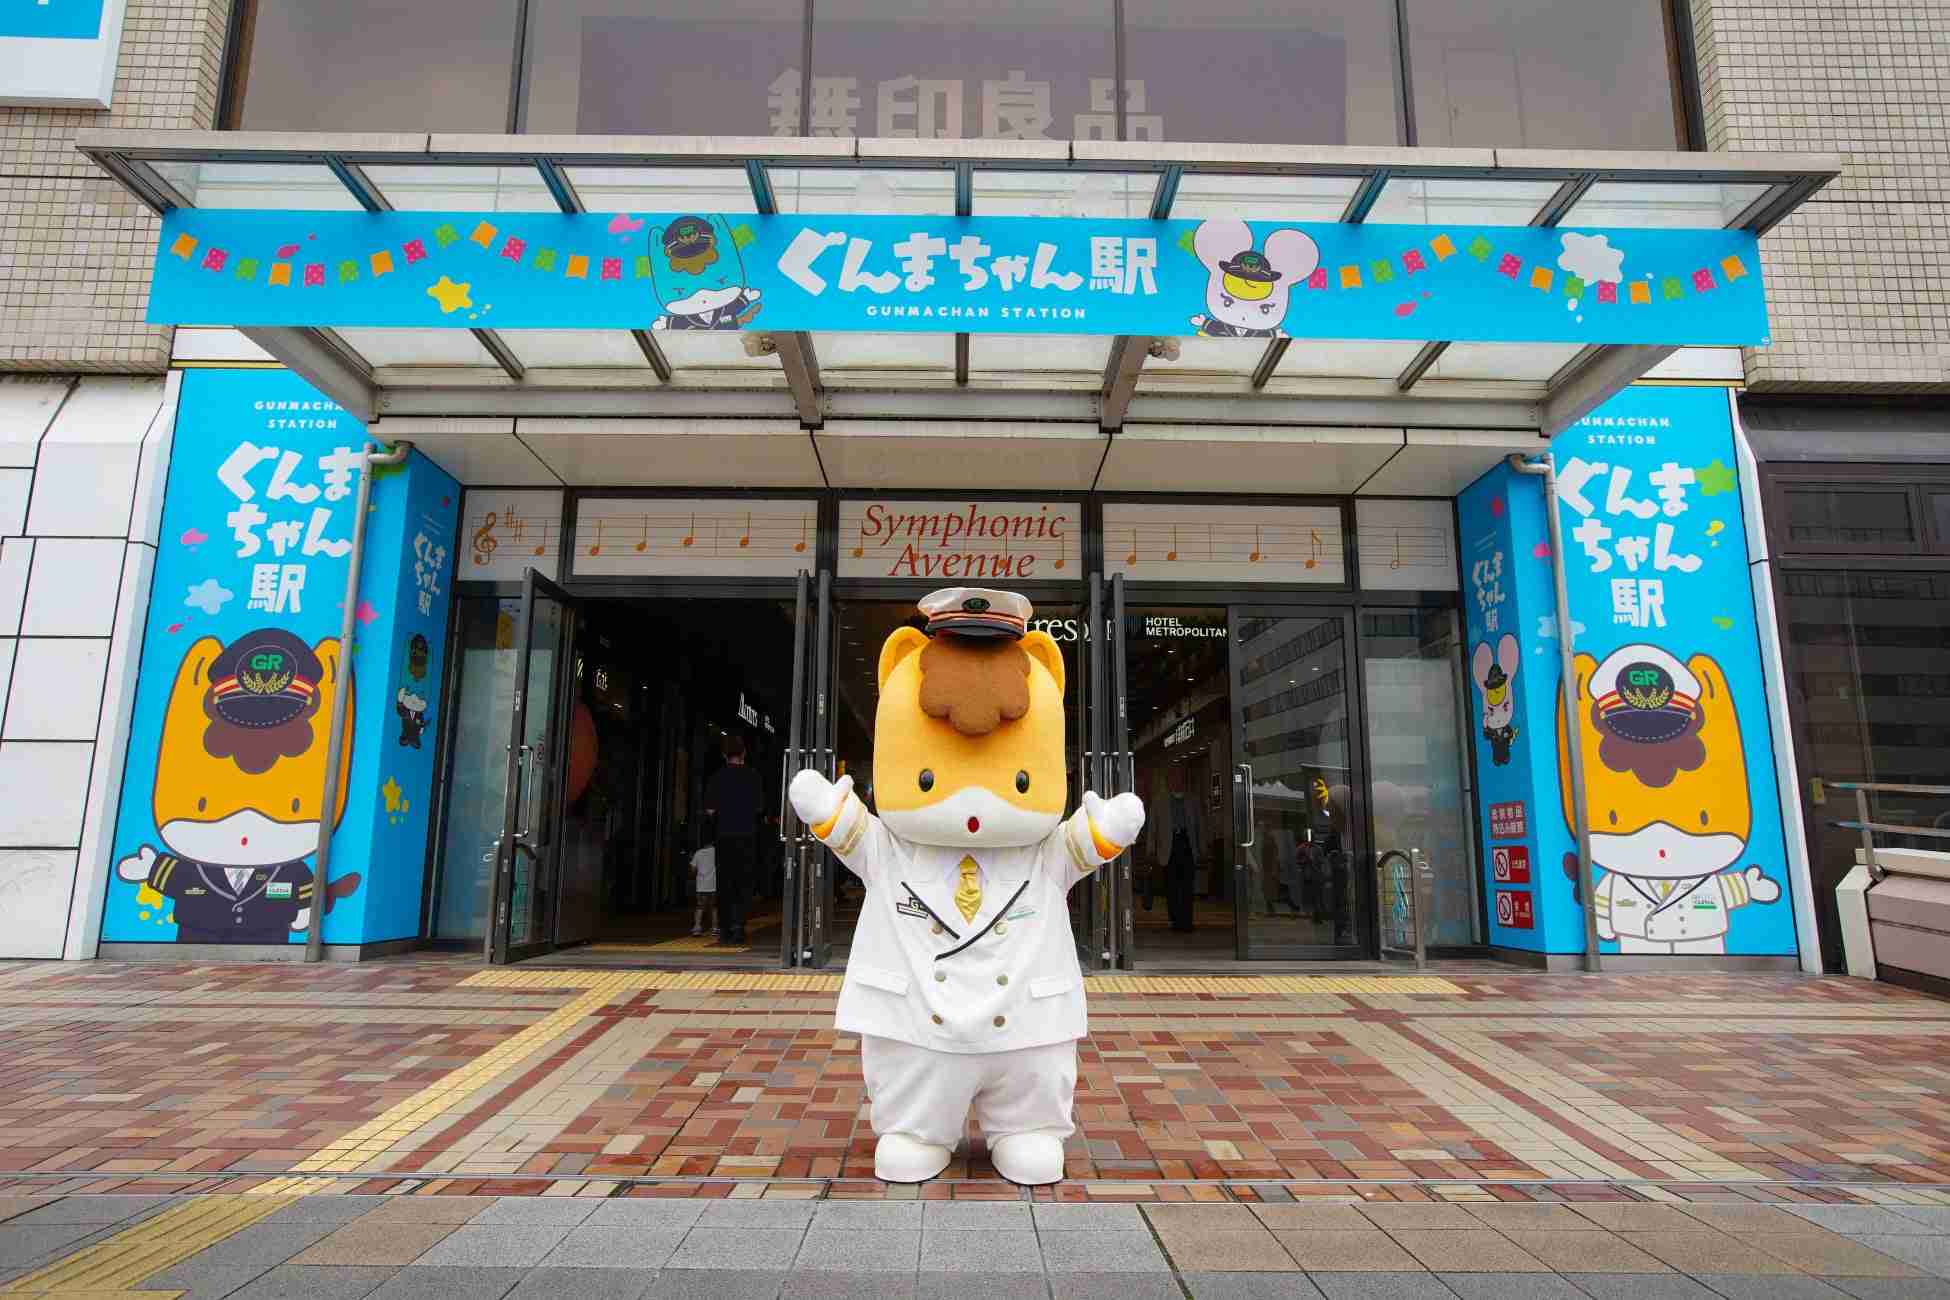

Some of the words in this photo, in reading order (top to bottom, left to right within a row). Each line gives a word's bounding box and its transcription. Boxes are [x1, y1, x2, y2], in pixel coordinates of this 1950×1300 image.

[767, 66, 1164, 141] 無印良品
[777, 227, 1158, 297] ぐんまちゃん駅
[866, 305, 990, 318] GUNMACHAN
[1001, 306, 1087, 320] STATION
[254, 400, 345, 411] GUNMACHA
[267, 418, 337, 429] STATION
[1587, 434, 1657, 445] STATION
[217, 440, 362, 504] ぐんま
[1557, 456, 1697, 519] ぐんま
[226, 503, 353, 559] ちゃん
[863, 504, 1066, 547] Symphonic
[1572, 518, 1703, 573] ちゃん
[888, 543, 1036, 578] Avenue
[247, 563, 306, 613] 駅
[1610, 578, 1667, 628] 駅
[1145, 617, 1183, 627] HOTEL
[252, 654, 284, 670] GR
[1629, 670, 1660, 686] GR
